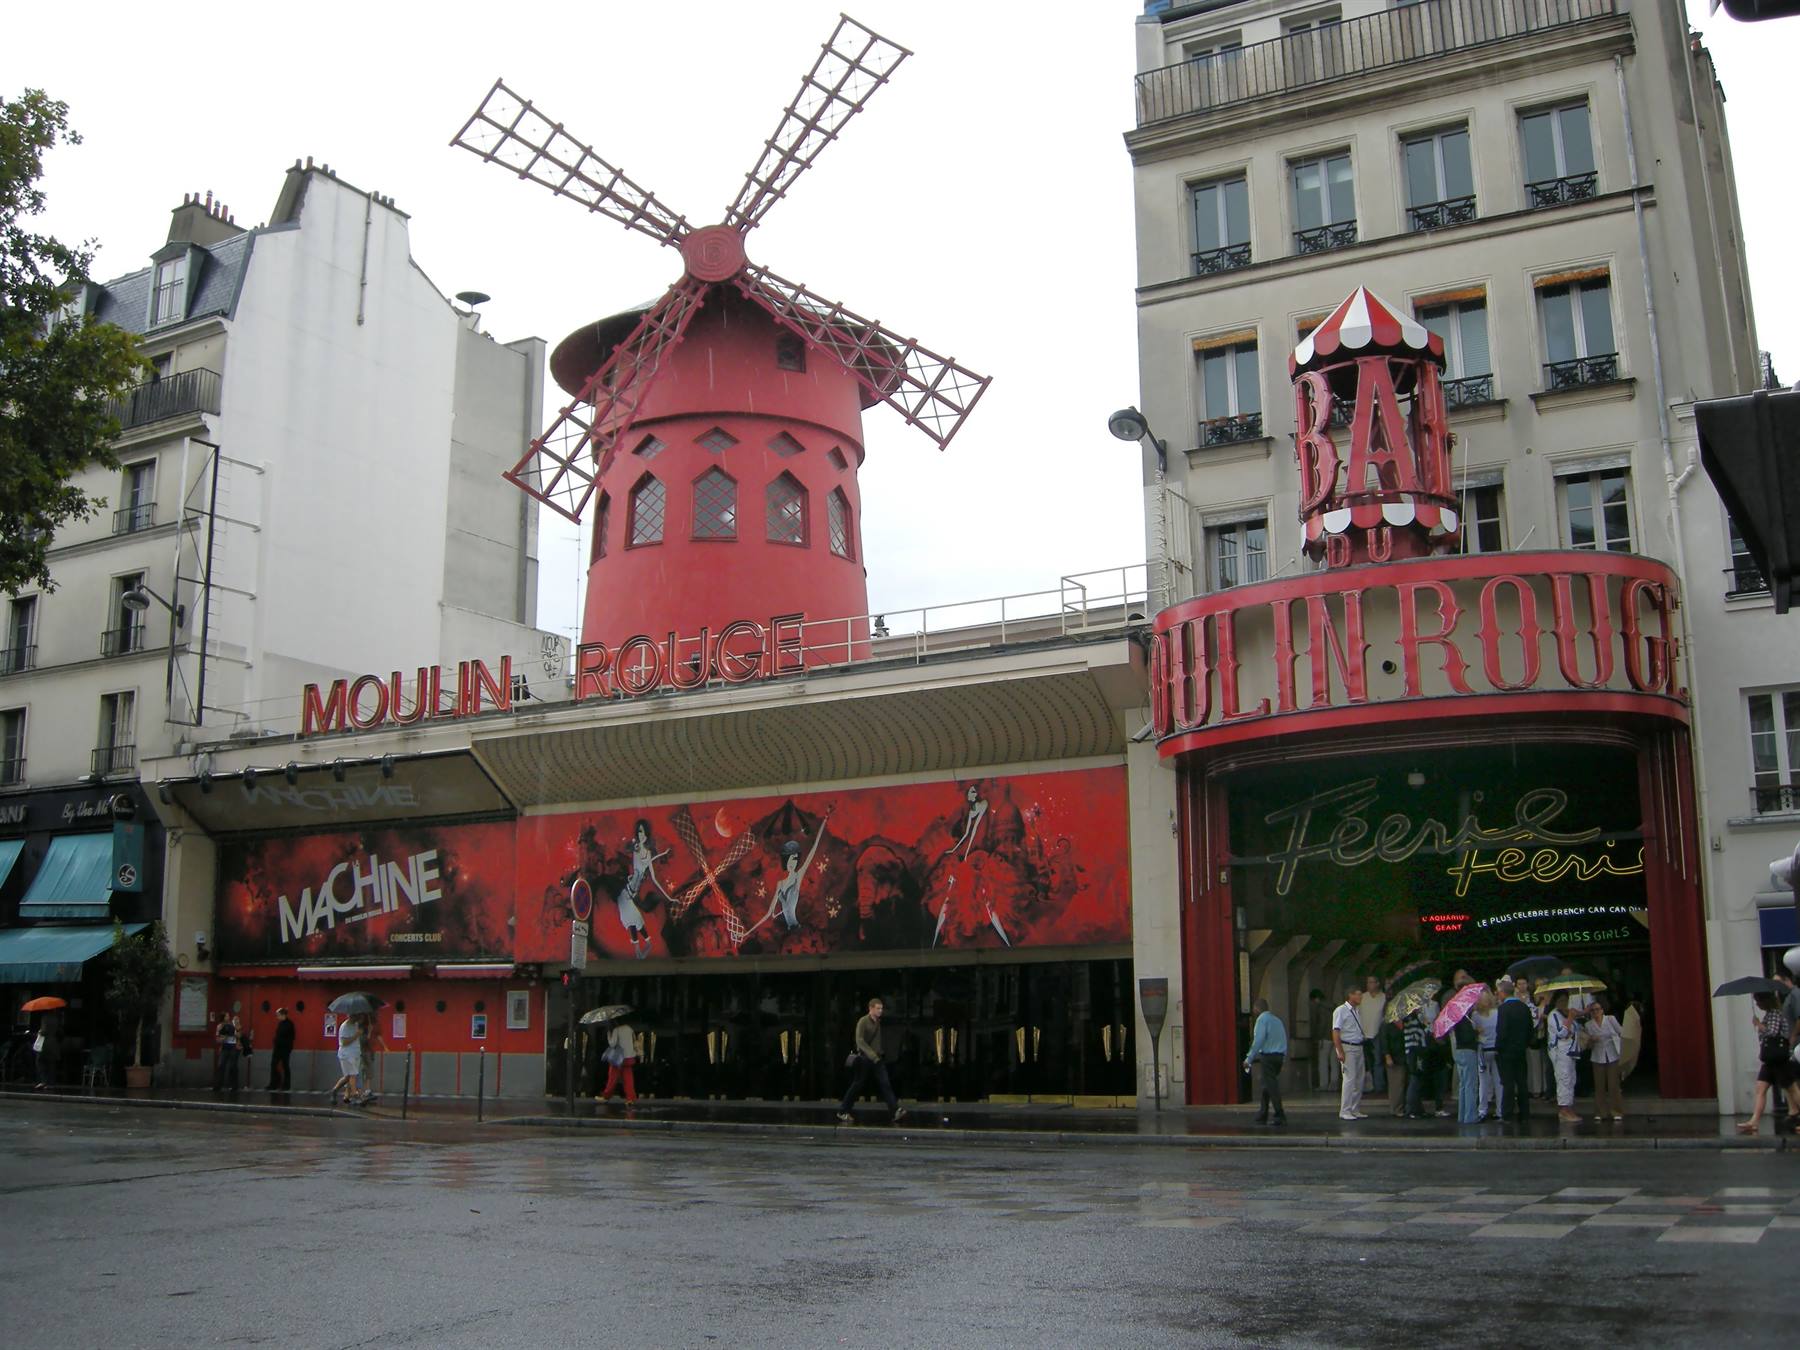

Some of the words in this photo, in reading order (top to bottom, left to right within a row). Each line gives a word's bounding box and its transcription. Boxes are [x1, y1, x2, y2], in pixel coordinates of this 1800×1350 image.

[1327, 526, 1392, 568] DU
[303, 655, 513, 736] MOULIN
[575, 612, 807, 701] ROUGE
[278, 849, 443, 943] MACHINE
[1477, 919, 1488, 928] LE
[1490, 914, 1512, 925] PLUS
[1512, 909, 1549, 919] CELEBRE
[1551, 906, 1585, 917] FRENCH
[1609, 905, 1627, 913] CAN
[1517, 932, 1539, 942] LES
[1543, 931, 1590, 943] DORISS
[1593, 926, 1630, 941] GIRLS
